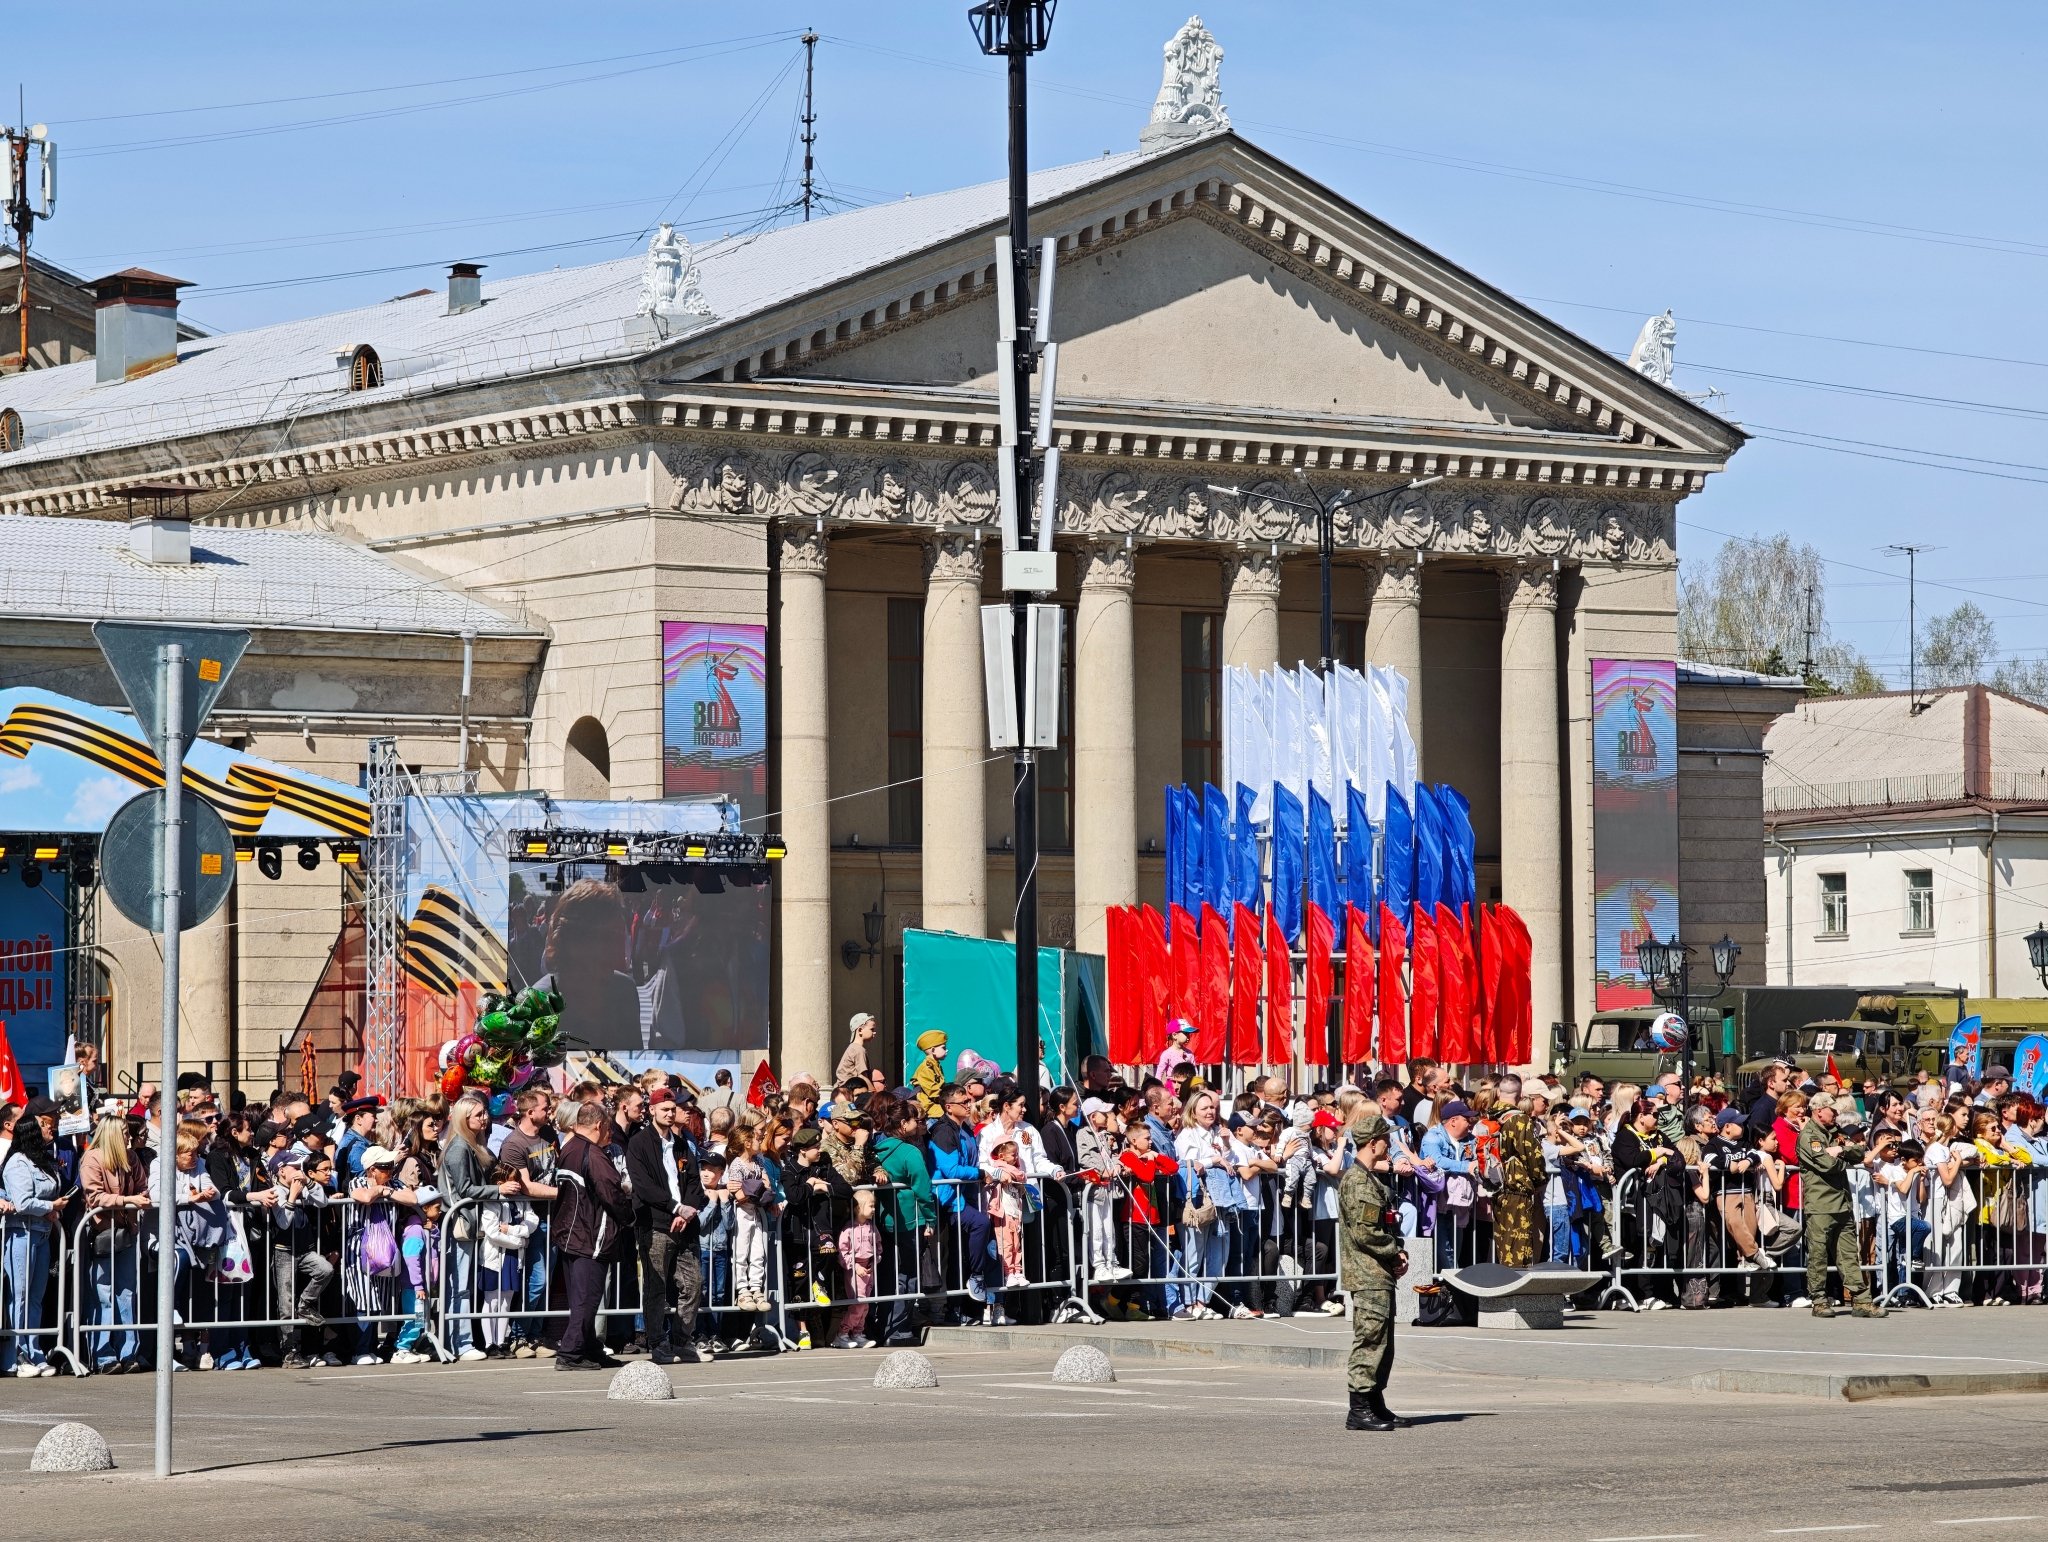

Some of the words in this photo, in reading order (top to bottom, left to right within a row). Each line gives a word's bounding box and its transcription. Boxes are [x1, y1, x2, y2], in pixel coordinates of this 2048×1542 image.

[694, 701, 719, 727] 80
[694, 732, 741, 748] ПОБЕДА!
[1618, 731, 1639, 753] 80
[1617, 759, 1658, 773] ПОБЕДА!
